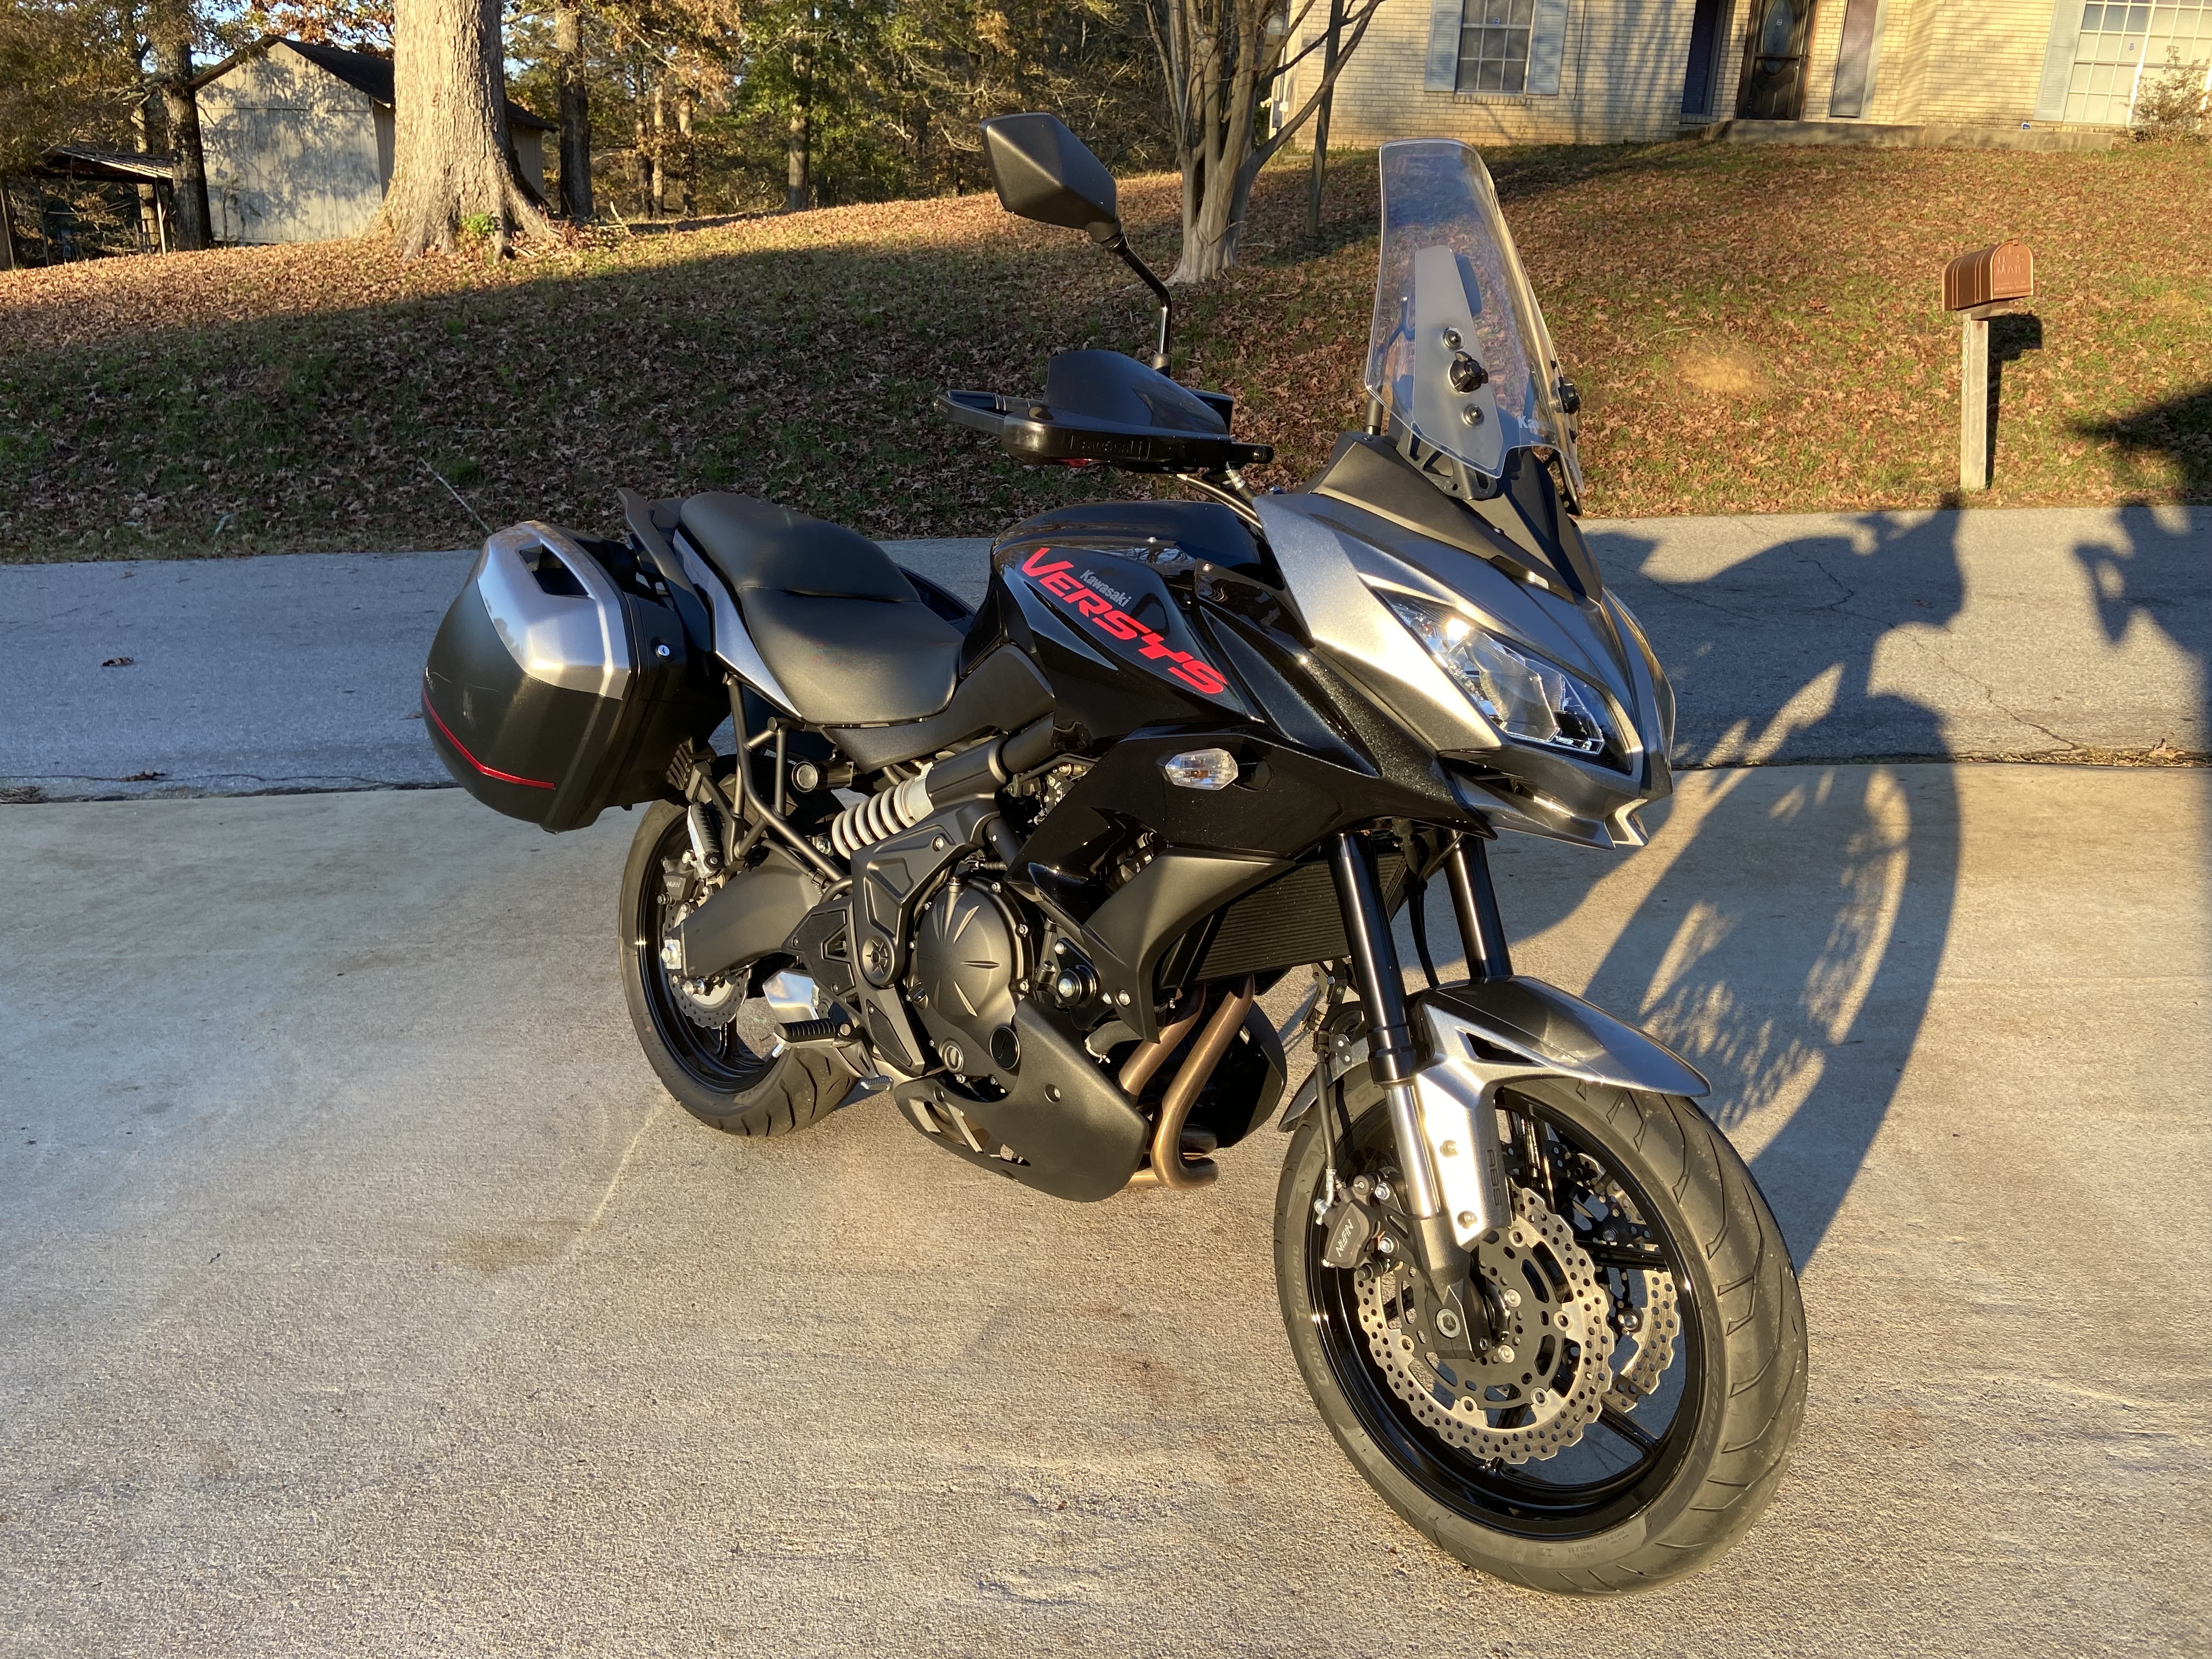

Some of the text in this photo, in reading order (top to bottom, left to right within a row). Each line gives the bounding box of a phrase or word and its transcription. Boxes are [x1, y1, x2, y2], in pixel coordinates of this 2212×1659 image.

[1997, 264, 2027, 275] MAIL
[1079, 569, 1132, 607] Kawasaki
[1021, 548, 1229, 694] VERSYS
[1486, 1149, 1503, 1206] ABS
[1335, 1218, 1354, 1258] NISSIN
[1293, 1244, 1307, 1321] TURISMO
